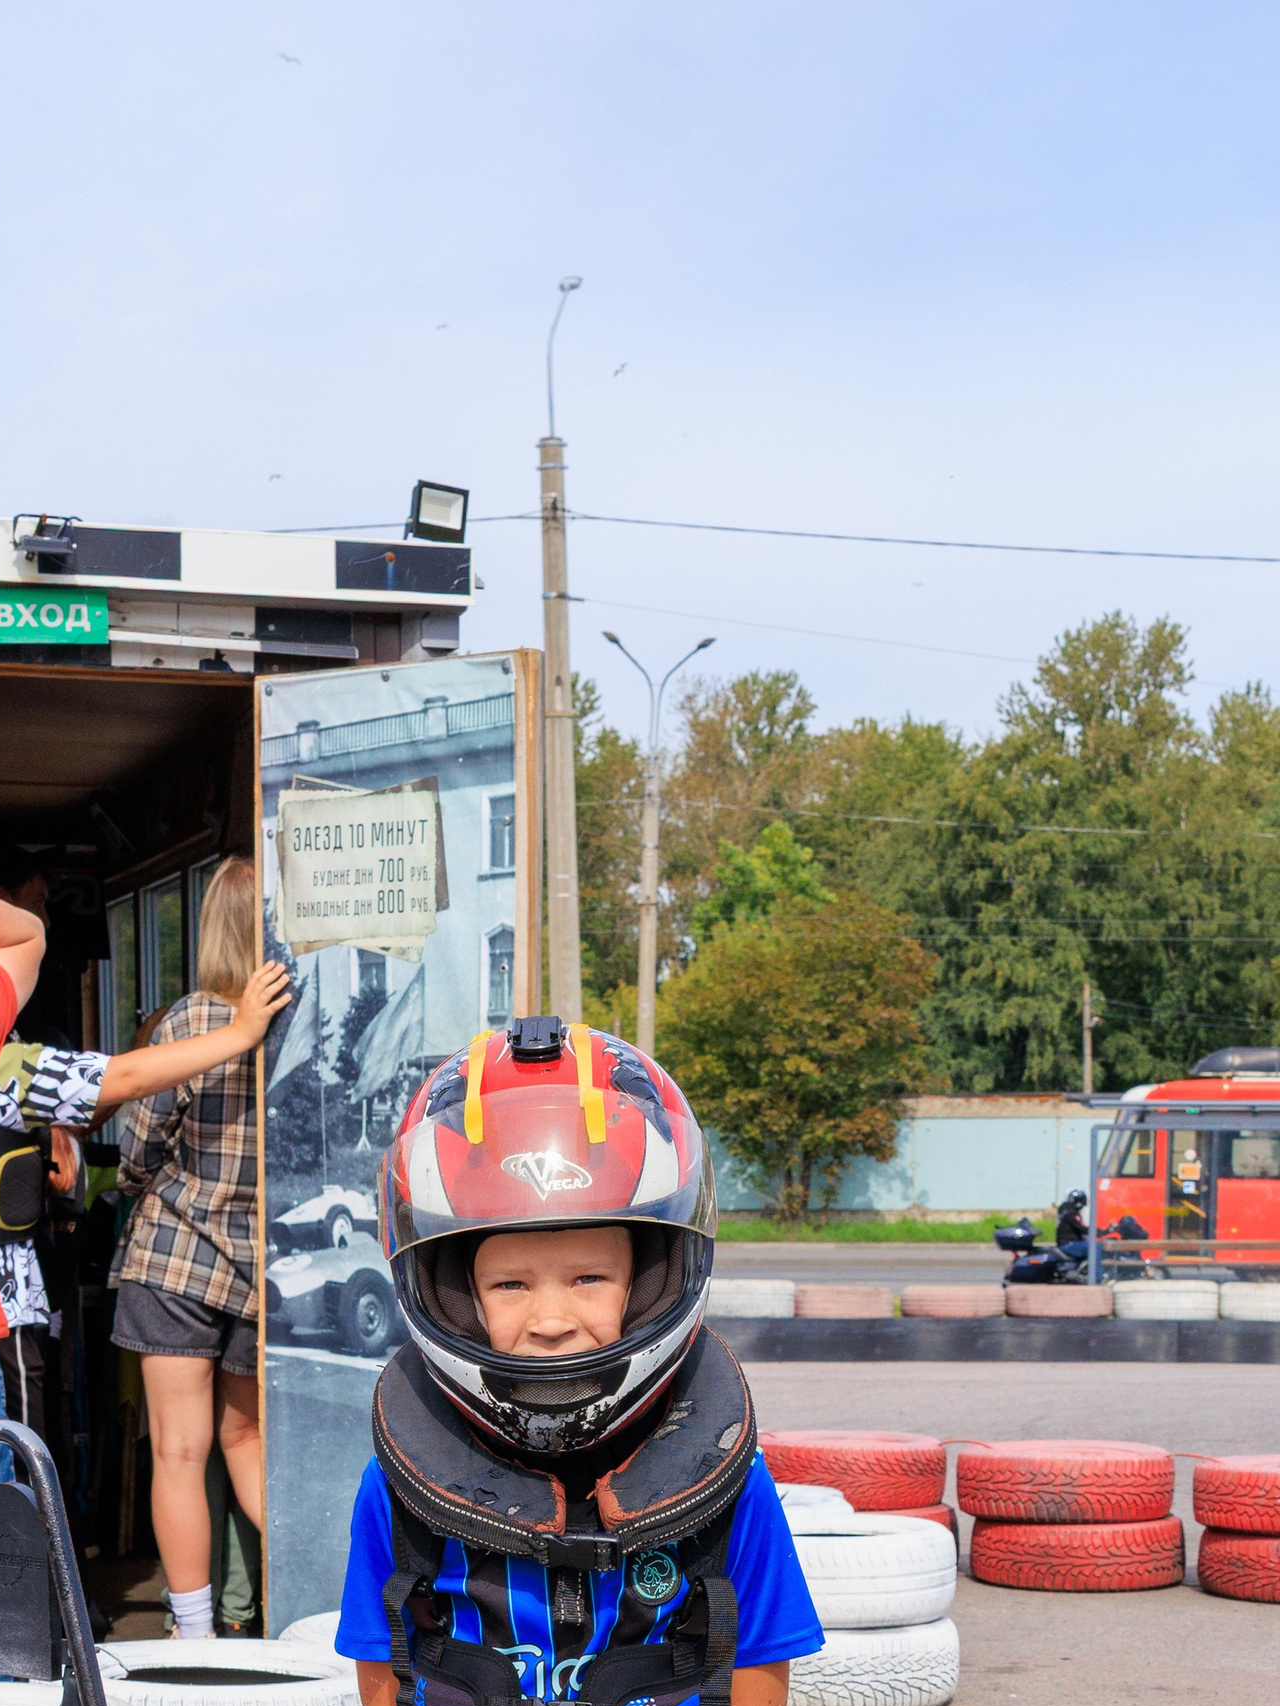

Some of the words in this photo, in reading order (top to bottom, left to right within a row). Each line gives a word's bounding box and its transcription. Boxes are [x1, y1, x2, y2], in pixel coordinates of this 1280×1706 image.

[293, 825, 343, 853] ЗАЕЗД
[349, 823, 365, 849] 10
[371, 819, 428, 848] МИНУТ
[313, 869, 351, 888] БУДНИЕ
[354, 868, 373, 886] ДНИ
[379, 857, 405, 883] 700
[410, 866, 432, 882] РУБ.
[296, 901, 350, 918] ВЫХОДНЫЕ
[353, 900, 373, 916] ДНИ
[377, 889, 405, 914] 800
[411, 897, 432, 913] РУБ.
[541, 1178, 583, 1192] VEGA
[632, 1549, 654, 1571] AJAX
